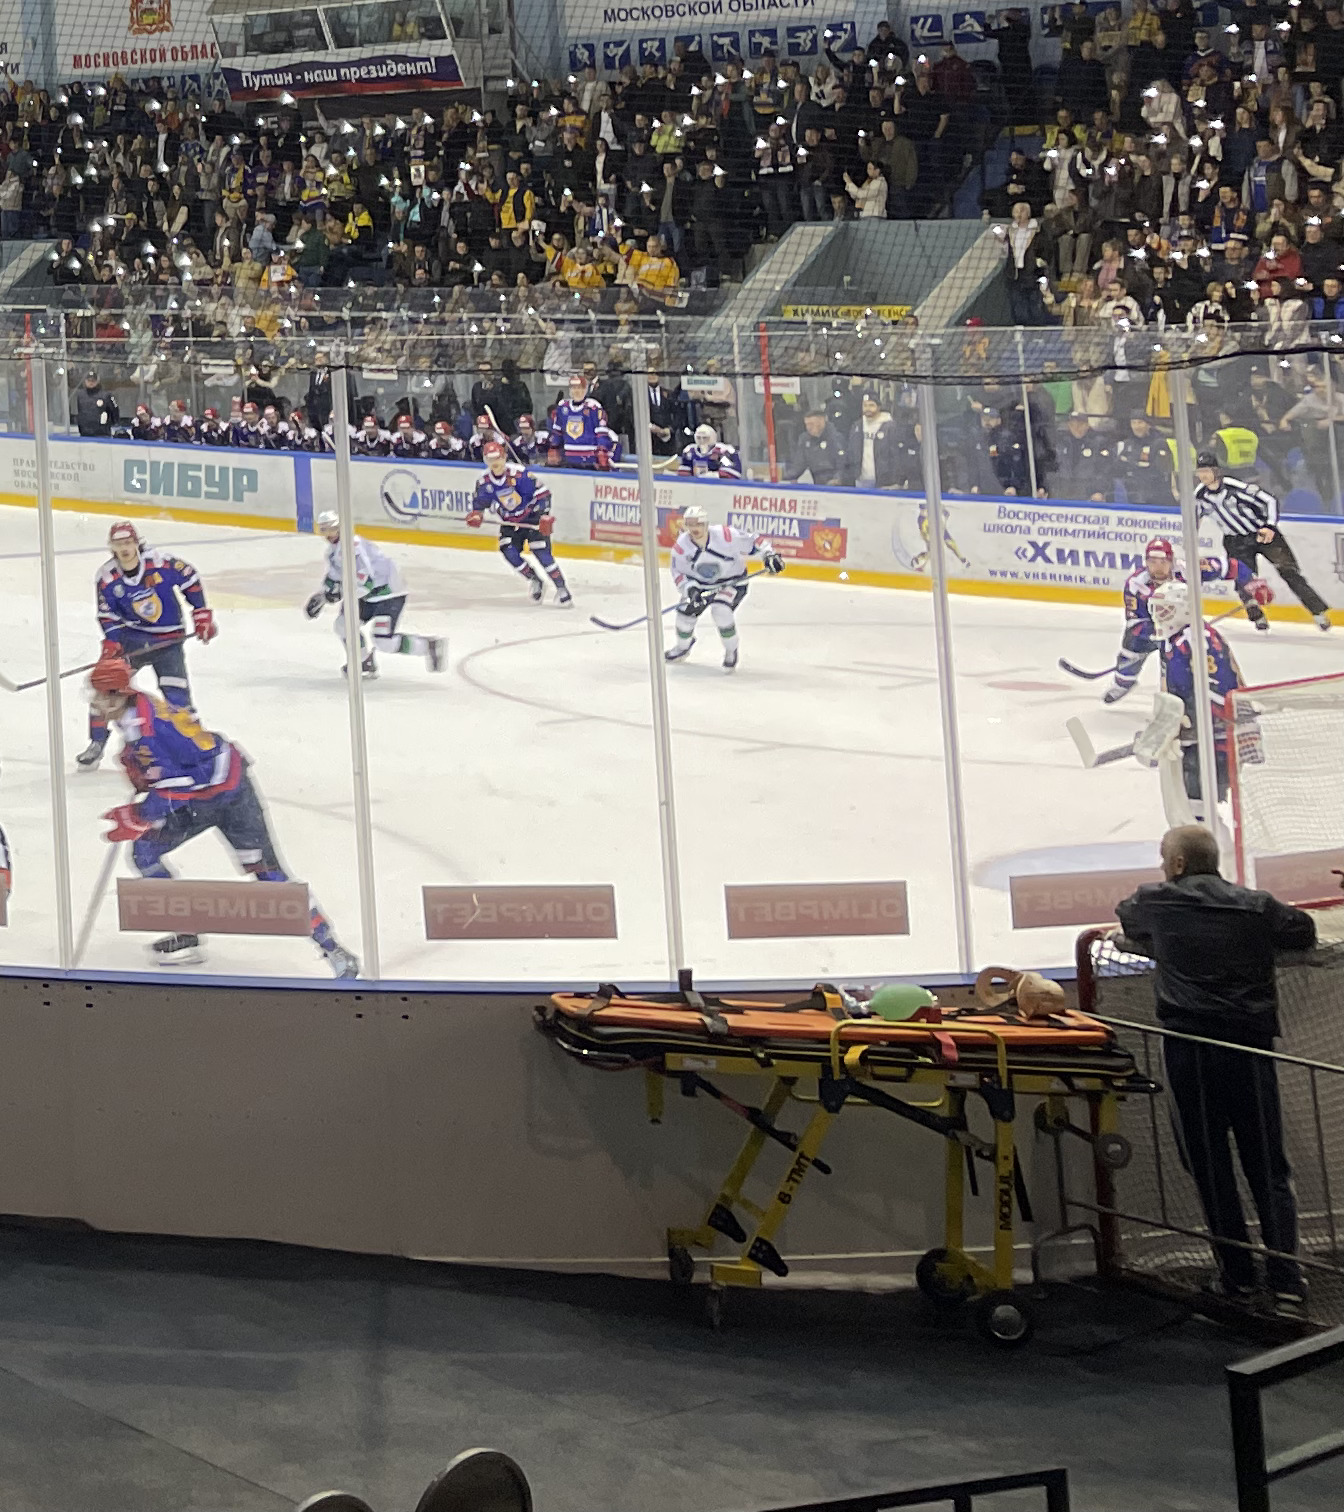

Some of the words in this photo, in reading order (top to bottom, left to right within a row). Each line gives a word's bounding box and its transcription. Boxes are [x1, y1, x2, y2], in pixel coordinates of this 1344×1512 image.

[603, 0, 723, 23] МОСКОВСКОЙ
[73, 45, 167, 69] МОСКОВСКОЙ
[171, 42, 218, 62] ОБЛАС
[241, 72, 292, 91] Путин
[305, 68, 337, 84] наш
[341, 57, 437, 83] президент!
[13, 458, 95, 472] ПРАВТЕЛЬСТВО
[14, 468, 80, 482] МОСКВСКОЙ
[124, 459, 259, 502] СИБУР
[421, 488, 474, 512] БУРЭНЕ
[733, 494, 798, 514] КРАСНАЯ
[731, 514, 800, 537] МАШИНА
[997, 505, 1110, 527] Воскресенская
[1115, 514, 1182, 531] хоккейна
[983, 522, 1031, 536] школа
[1037, 525, 1148, 544] олимпийского
[1013, 540, 1147, 570] «Хими
